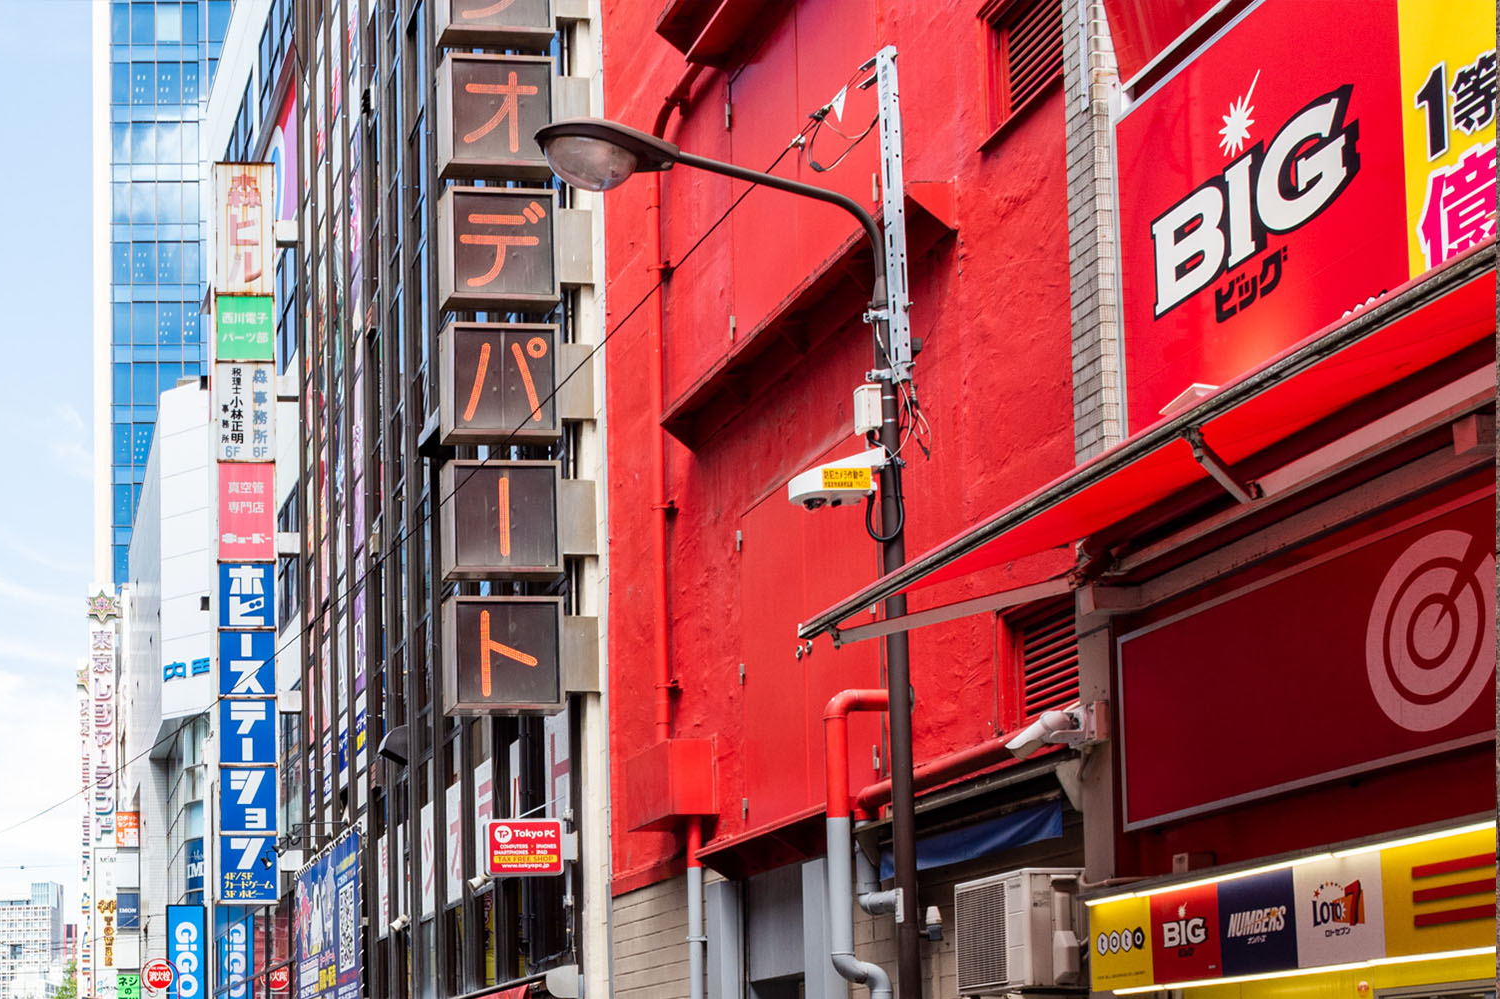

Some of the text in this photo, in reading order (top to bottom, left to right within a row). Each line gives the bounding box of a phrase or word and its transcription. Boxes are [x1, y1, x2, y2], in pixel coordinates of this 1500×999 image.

[1416, 50, 1496, 162] 1等
[1152, 84, 1361, 319] BIG
[1215, 246, 1285, 324] ビッグ
[222, 312, 268, 325] 西川電子
[222, 332, 269, 344] パーツ部
[460, 0, 547, 698] オデパート
[252, 368, 268, 444] 森事務所
[225, 446, 241, 457] 6F
[228, 481, 264, 494] 真空管
[228, 501, 264, 513] 専門店
[91, 630, 114, 841] 東京レジャーランド
[514, 829, 555, 839] Tokyo PC
[224, 872, 254, 881] 4F/5F
[224, 881, 274, 889] カードゲーム
[224, 890, 264, 898] 3F ホビー
[1312, 899, 1346, 927] LOTO
[1228, 905, 1286, 938] NUMBERS
[1162, 917, 1208, 949] BIG
[1325, 928, 1350, 938] ロトセブン
[1098, 926, 1145, 956] toto
[149, 971, 170, 982] 消火栓
[125, 987, 132, 995] の
